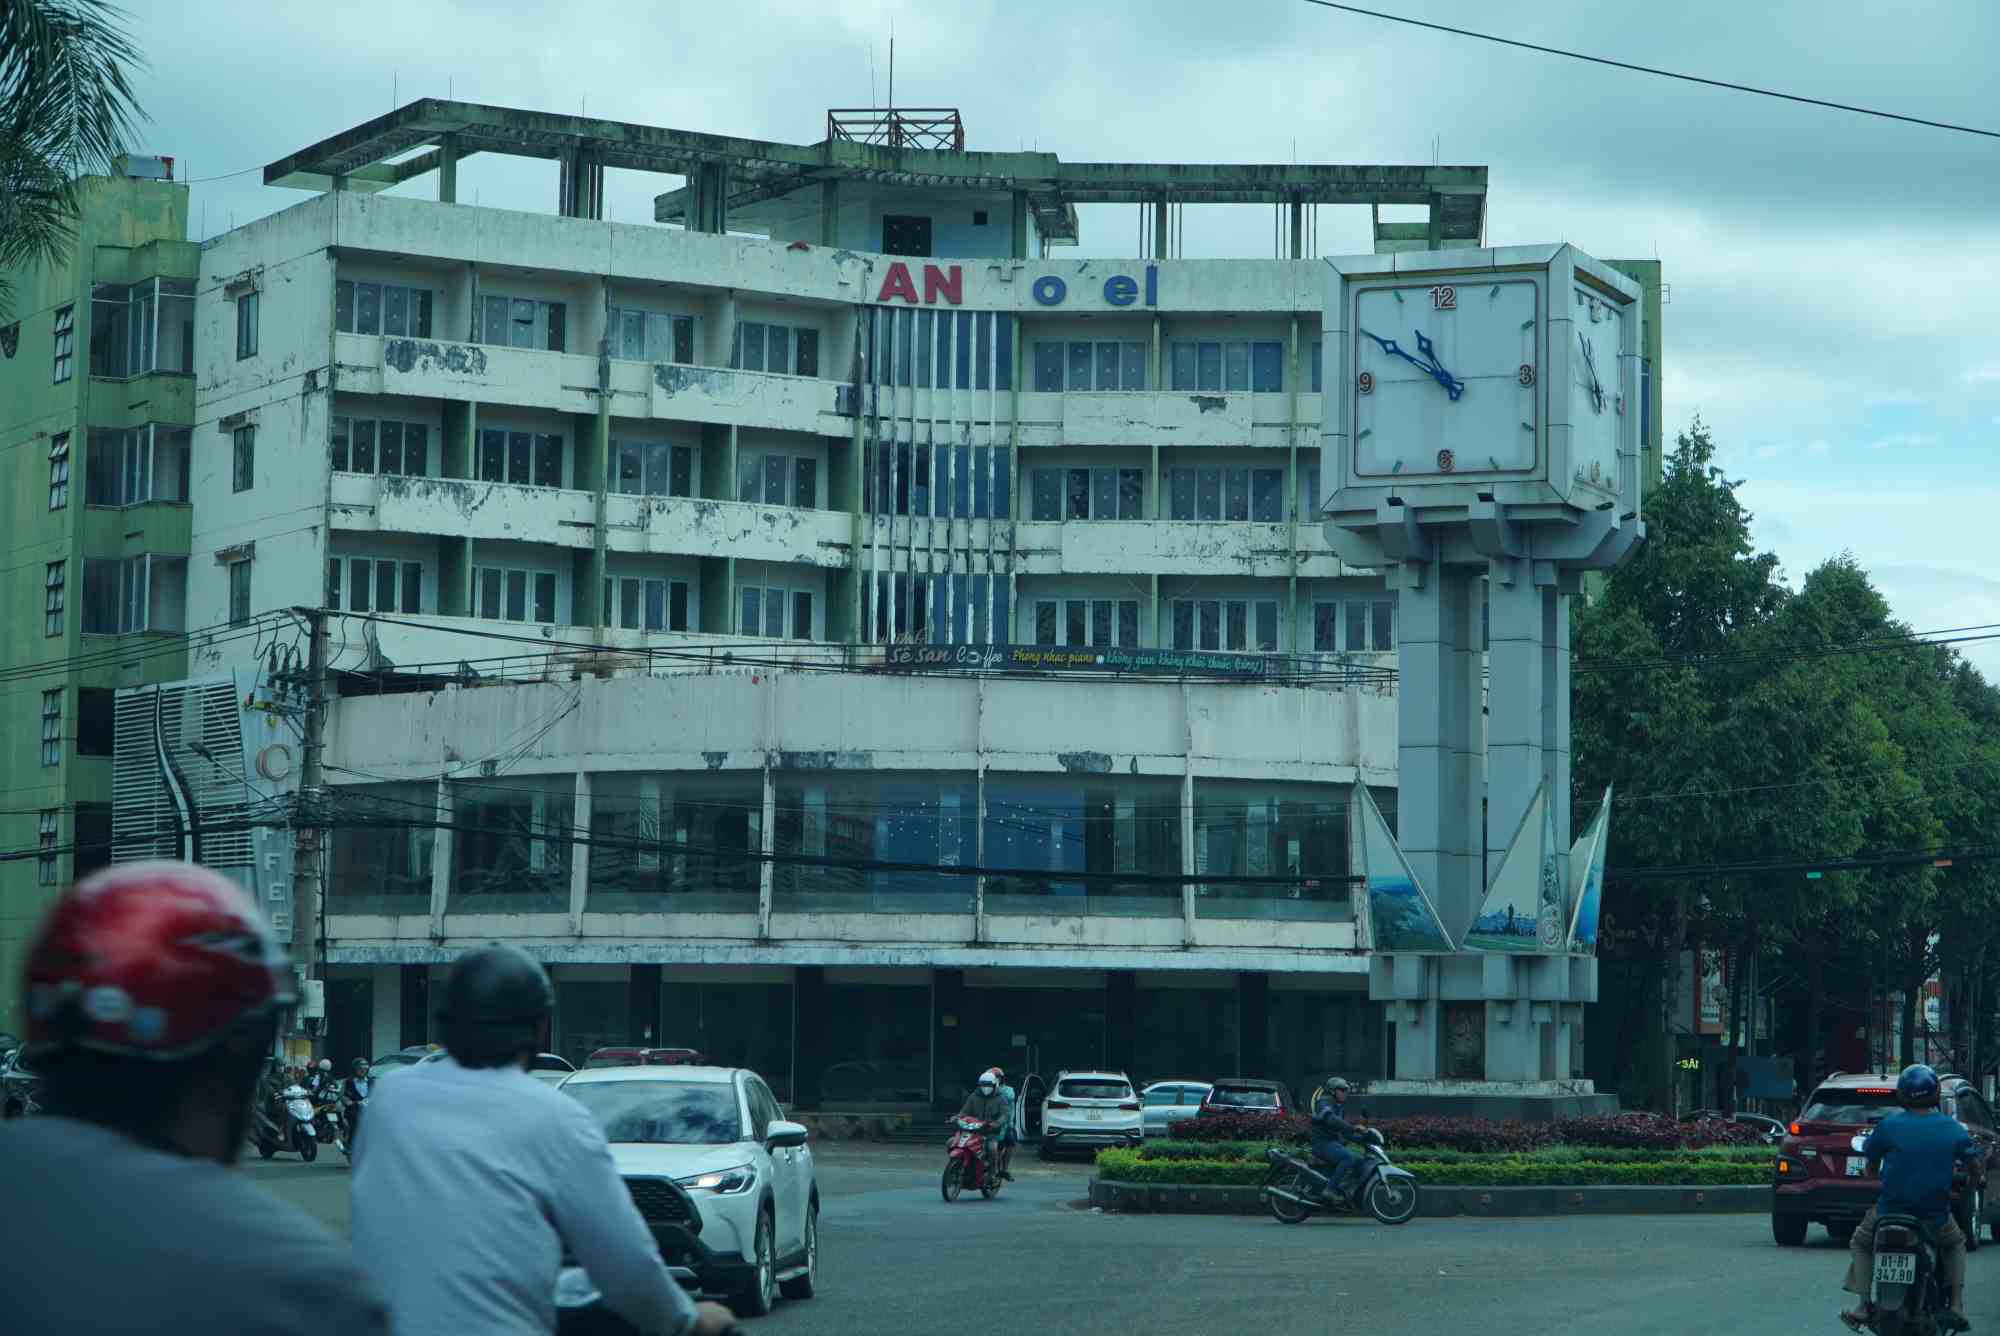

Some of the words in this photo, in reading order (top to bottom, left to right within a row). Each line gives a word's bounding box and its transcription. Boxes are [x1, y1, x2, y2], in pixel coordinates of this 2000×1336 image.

[877, 262, 963, 304] AN
[1429, 286, 1457, 310] 12
[1359, 372, 1376, 394] 9
[1520, 364, 1536, 387] 3
[1437, 449, 1456, 472] 6
